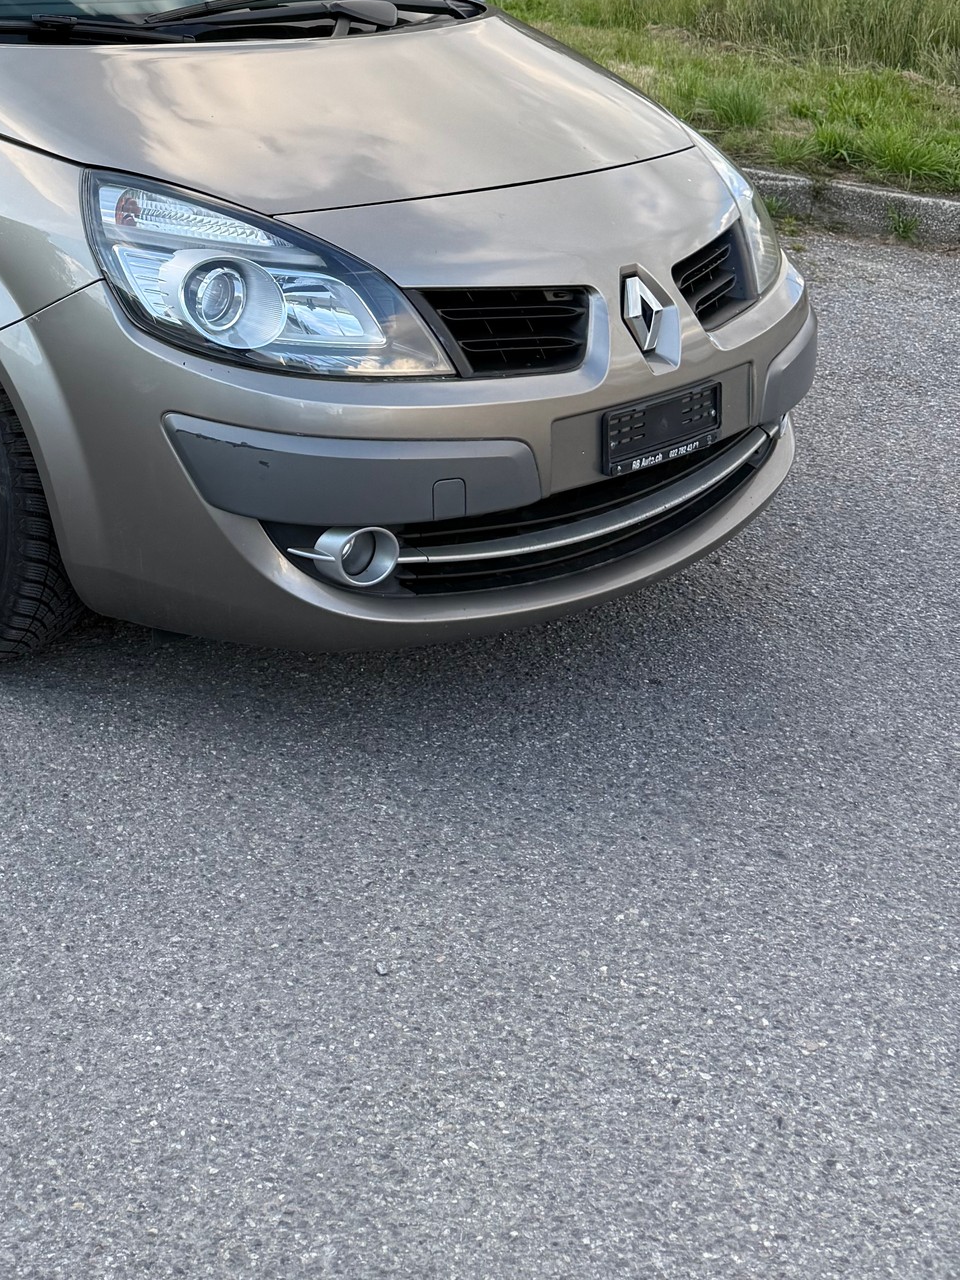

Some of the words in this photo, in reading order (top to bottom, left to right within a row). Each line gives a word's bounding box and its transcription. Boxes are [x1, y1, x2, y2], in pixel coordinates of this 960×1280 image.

[669, 449, 678, 458] 022
[632, 459, 641, 471] RB
[641, 452, 663, 467] Auto.ch
